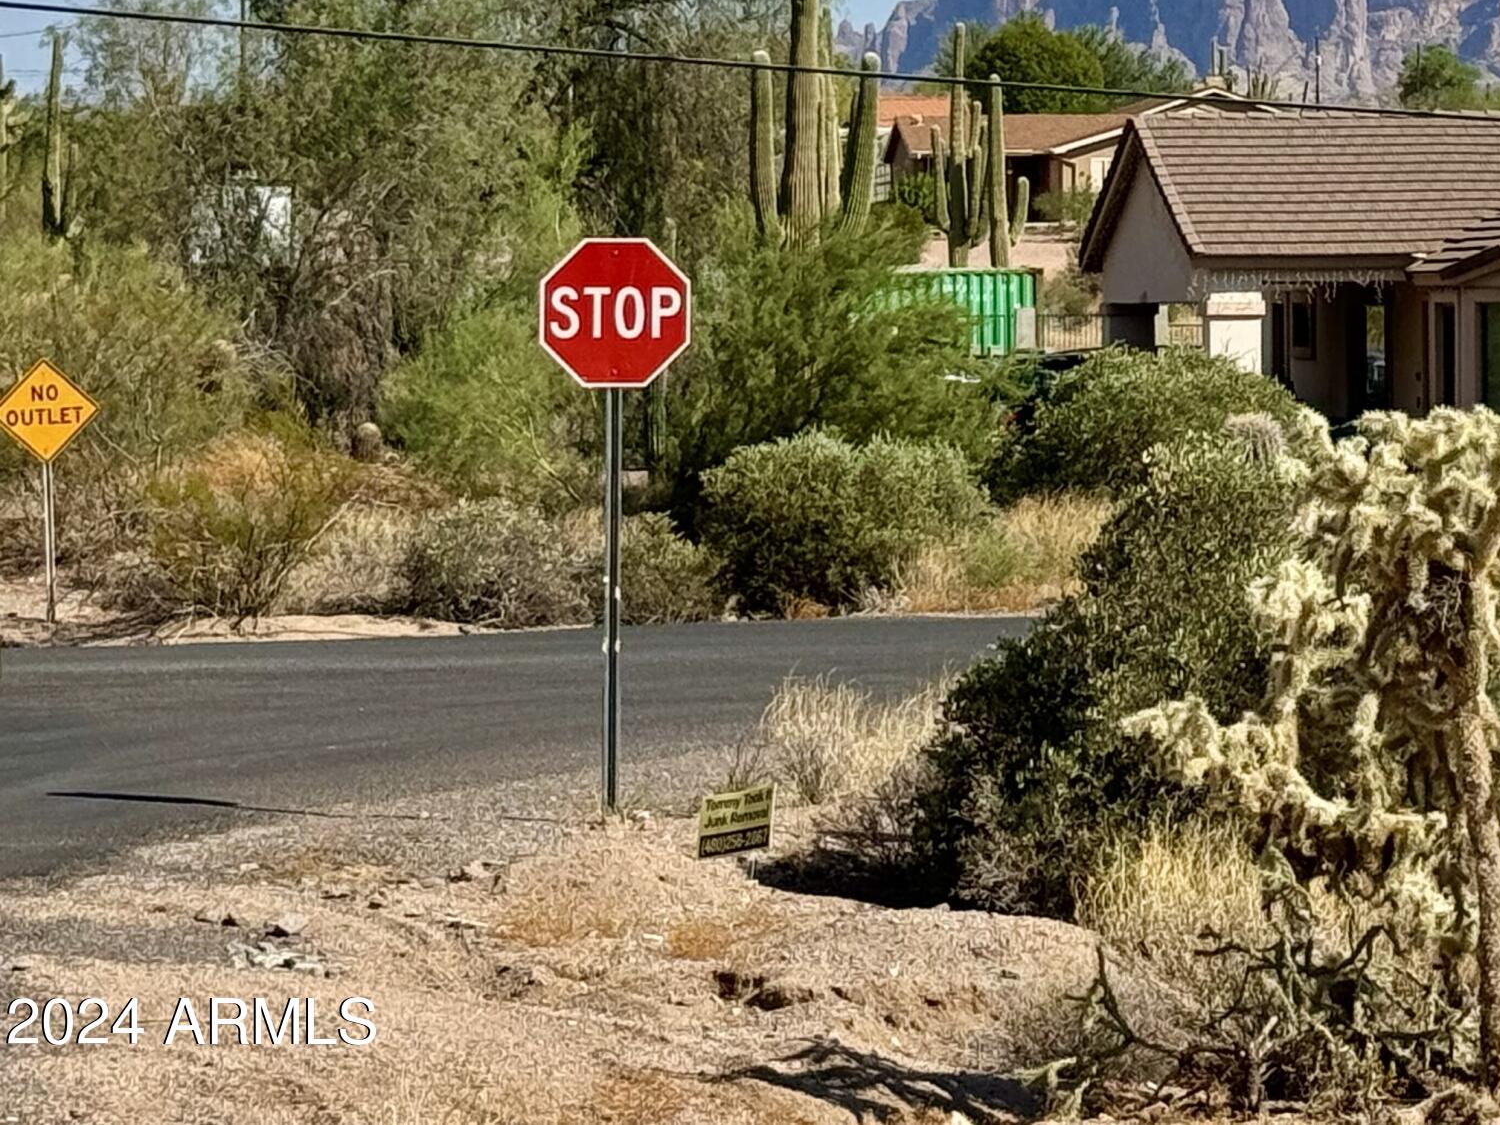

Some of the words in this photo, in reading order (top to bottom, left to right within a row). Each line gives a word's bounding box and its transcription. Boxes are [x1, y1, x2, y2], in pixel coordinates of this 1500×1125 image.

[550, 286, 682, 340] STOP
[31, 384, 59, 402] NO
[6, 406, 84, 427] OUTLET
[703, 815, 729, 829] Junk
[730, 803, 769, 823] Removal
